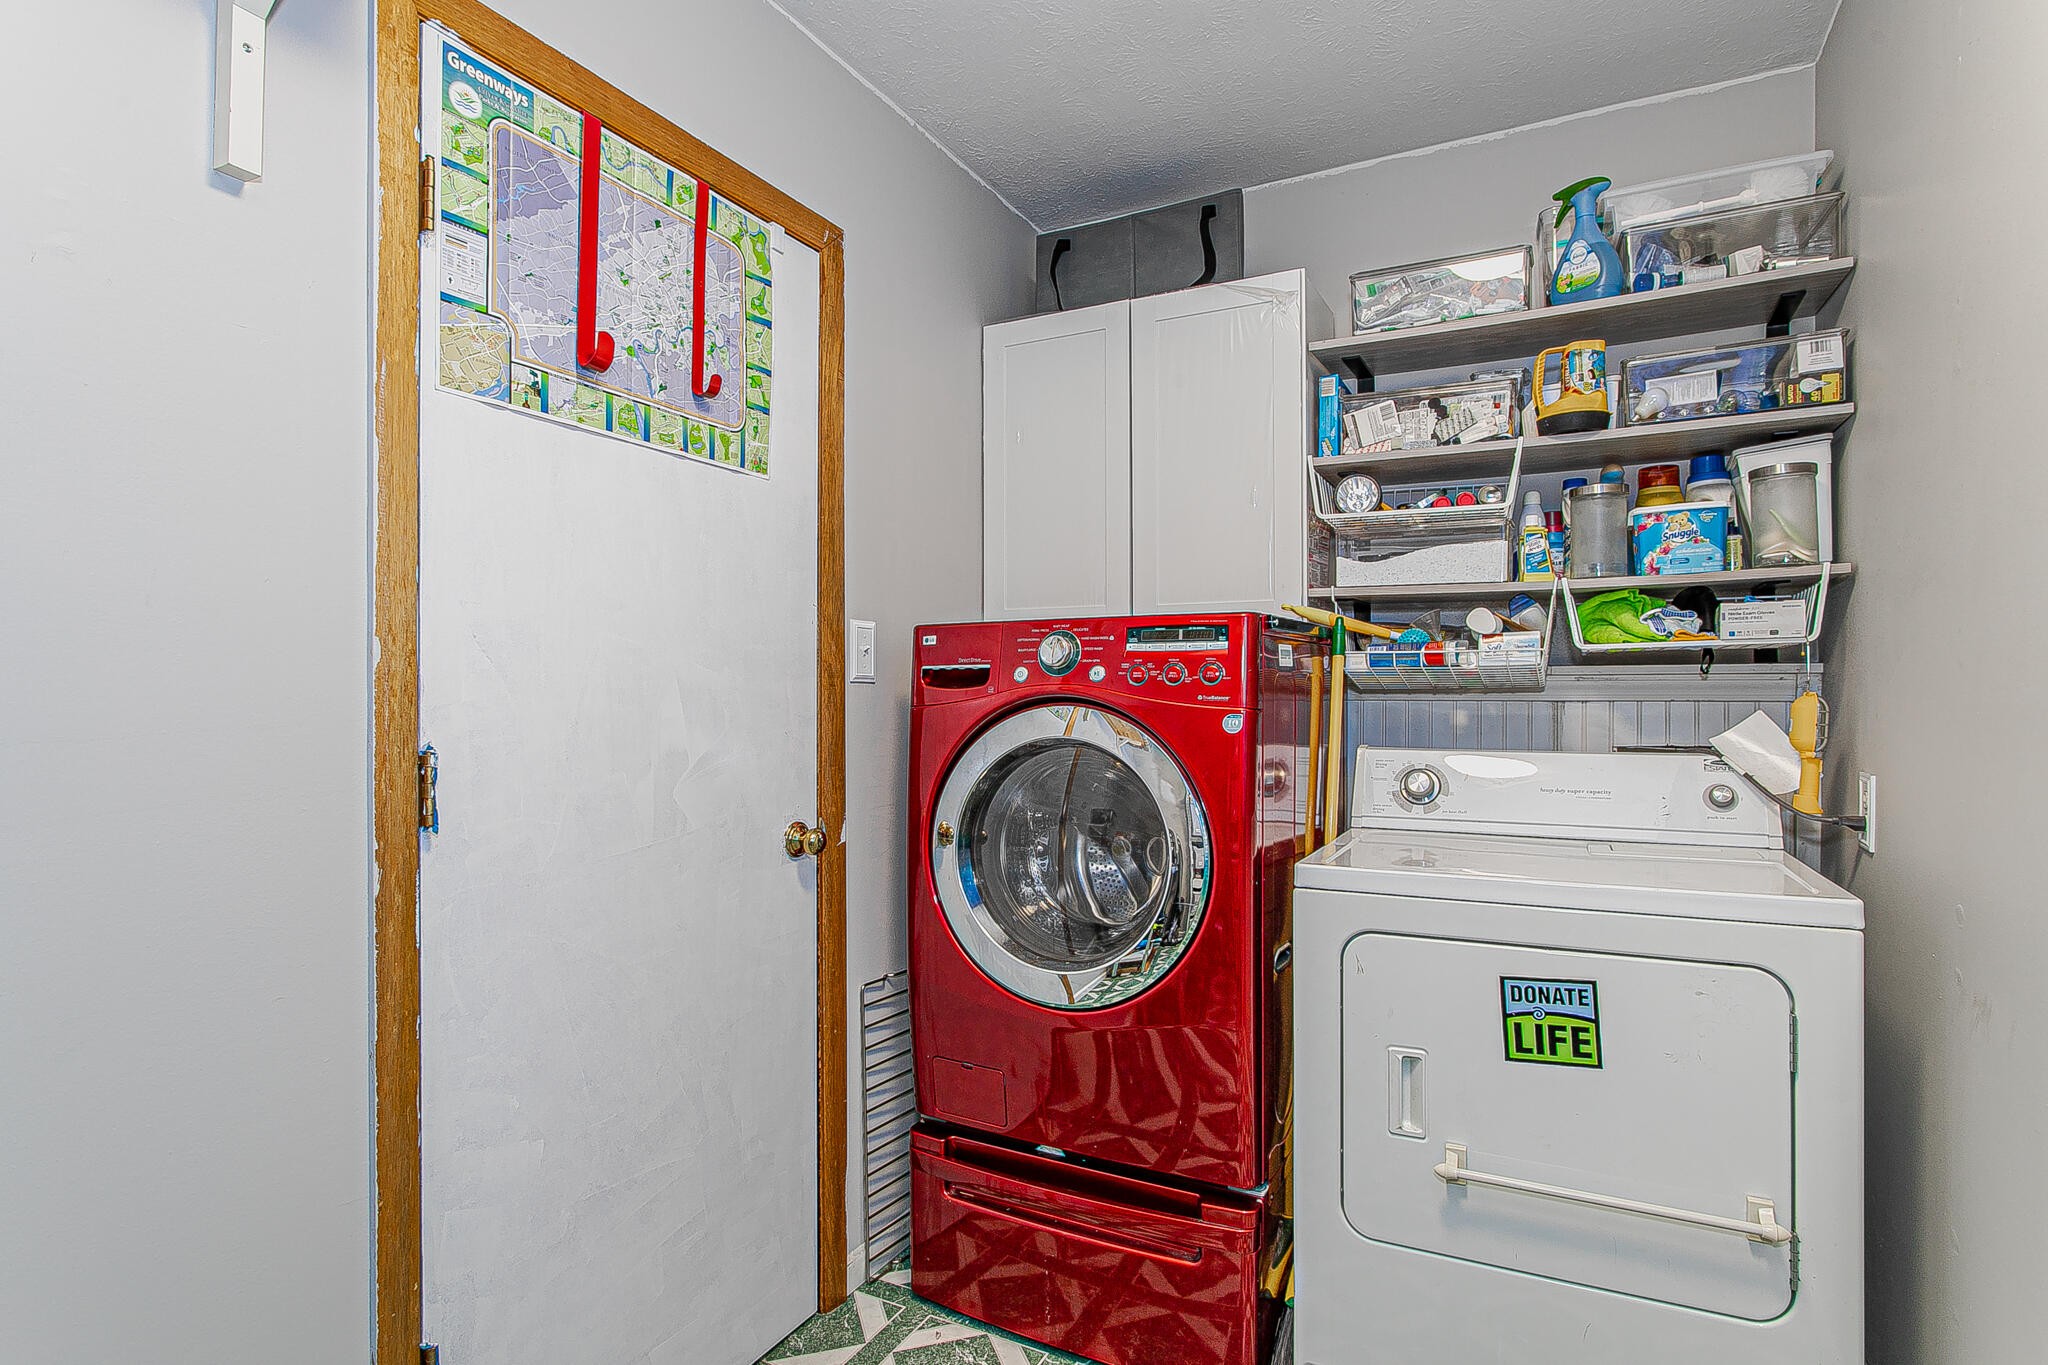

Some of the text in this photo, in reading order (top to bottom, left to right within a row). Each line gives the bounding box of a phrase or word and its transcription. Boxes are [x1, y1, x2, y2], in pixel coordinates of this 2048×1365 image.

[446, 51, 529, 108] Greenways
[1662, 528, 1699, 542] Snuggle
[1228, 719, 1239, 728] 10
[1510, 984, 1590, 1007] DONATE
[1513, 1022, 1593, 1059] LIFE
